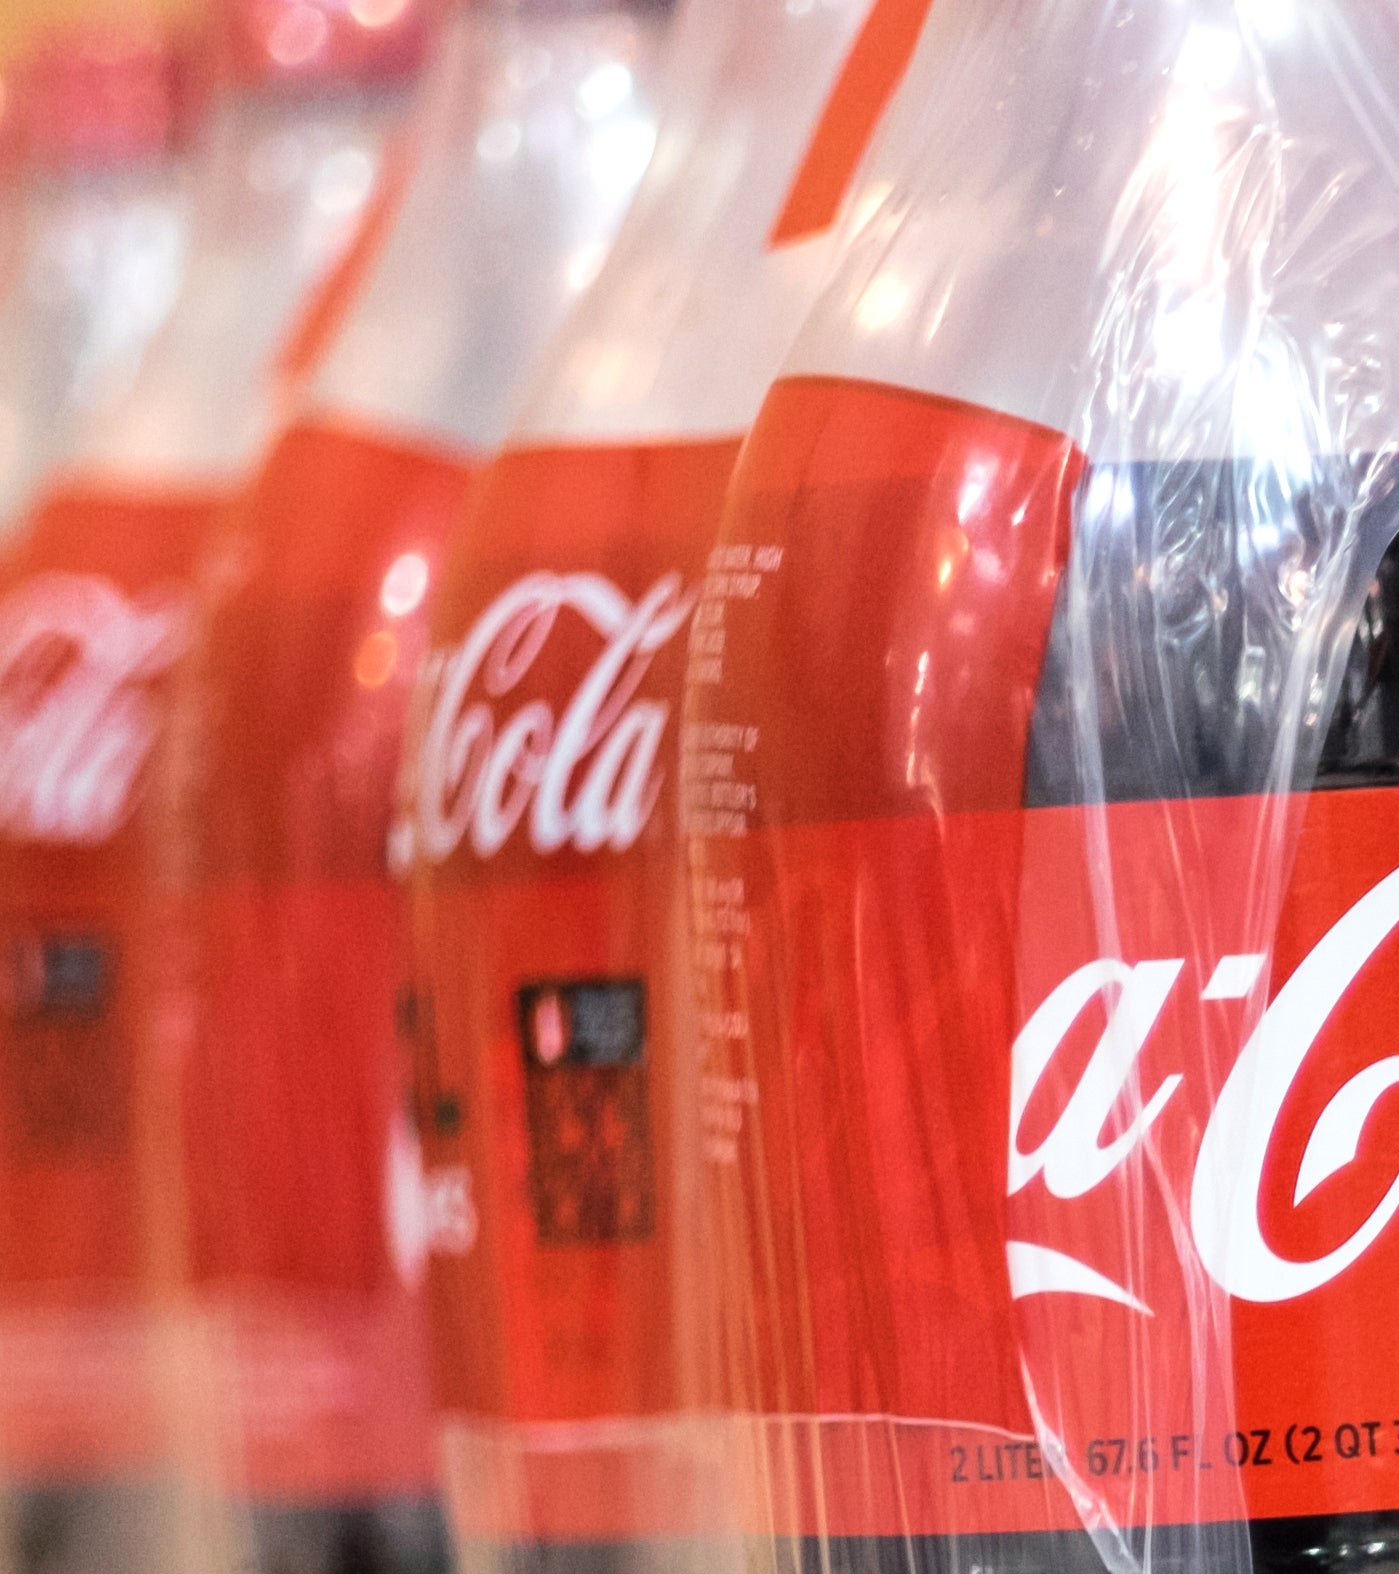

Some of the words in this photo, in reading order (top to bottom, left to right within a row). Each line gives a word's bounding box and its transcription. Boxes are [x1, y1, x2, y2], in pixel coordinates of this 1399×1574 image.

[950, 1445, 970, 1483] 2
[977, 1438, 1066, 1483] LITE
[1087, 1436, 1160, 1477] 67.6
[1224, 1429, 1273, 1468] OZ
[1285, 1423, 1323, 1465] (2
[1333, 1420, 1382, 1459] QT
